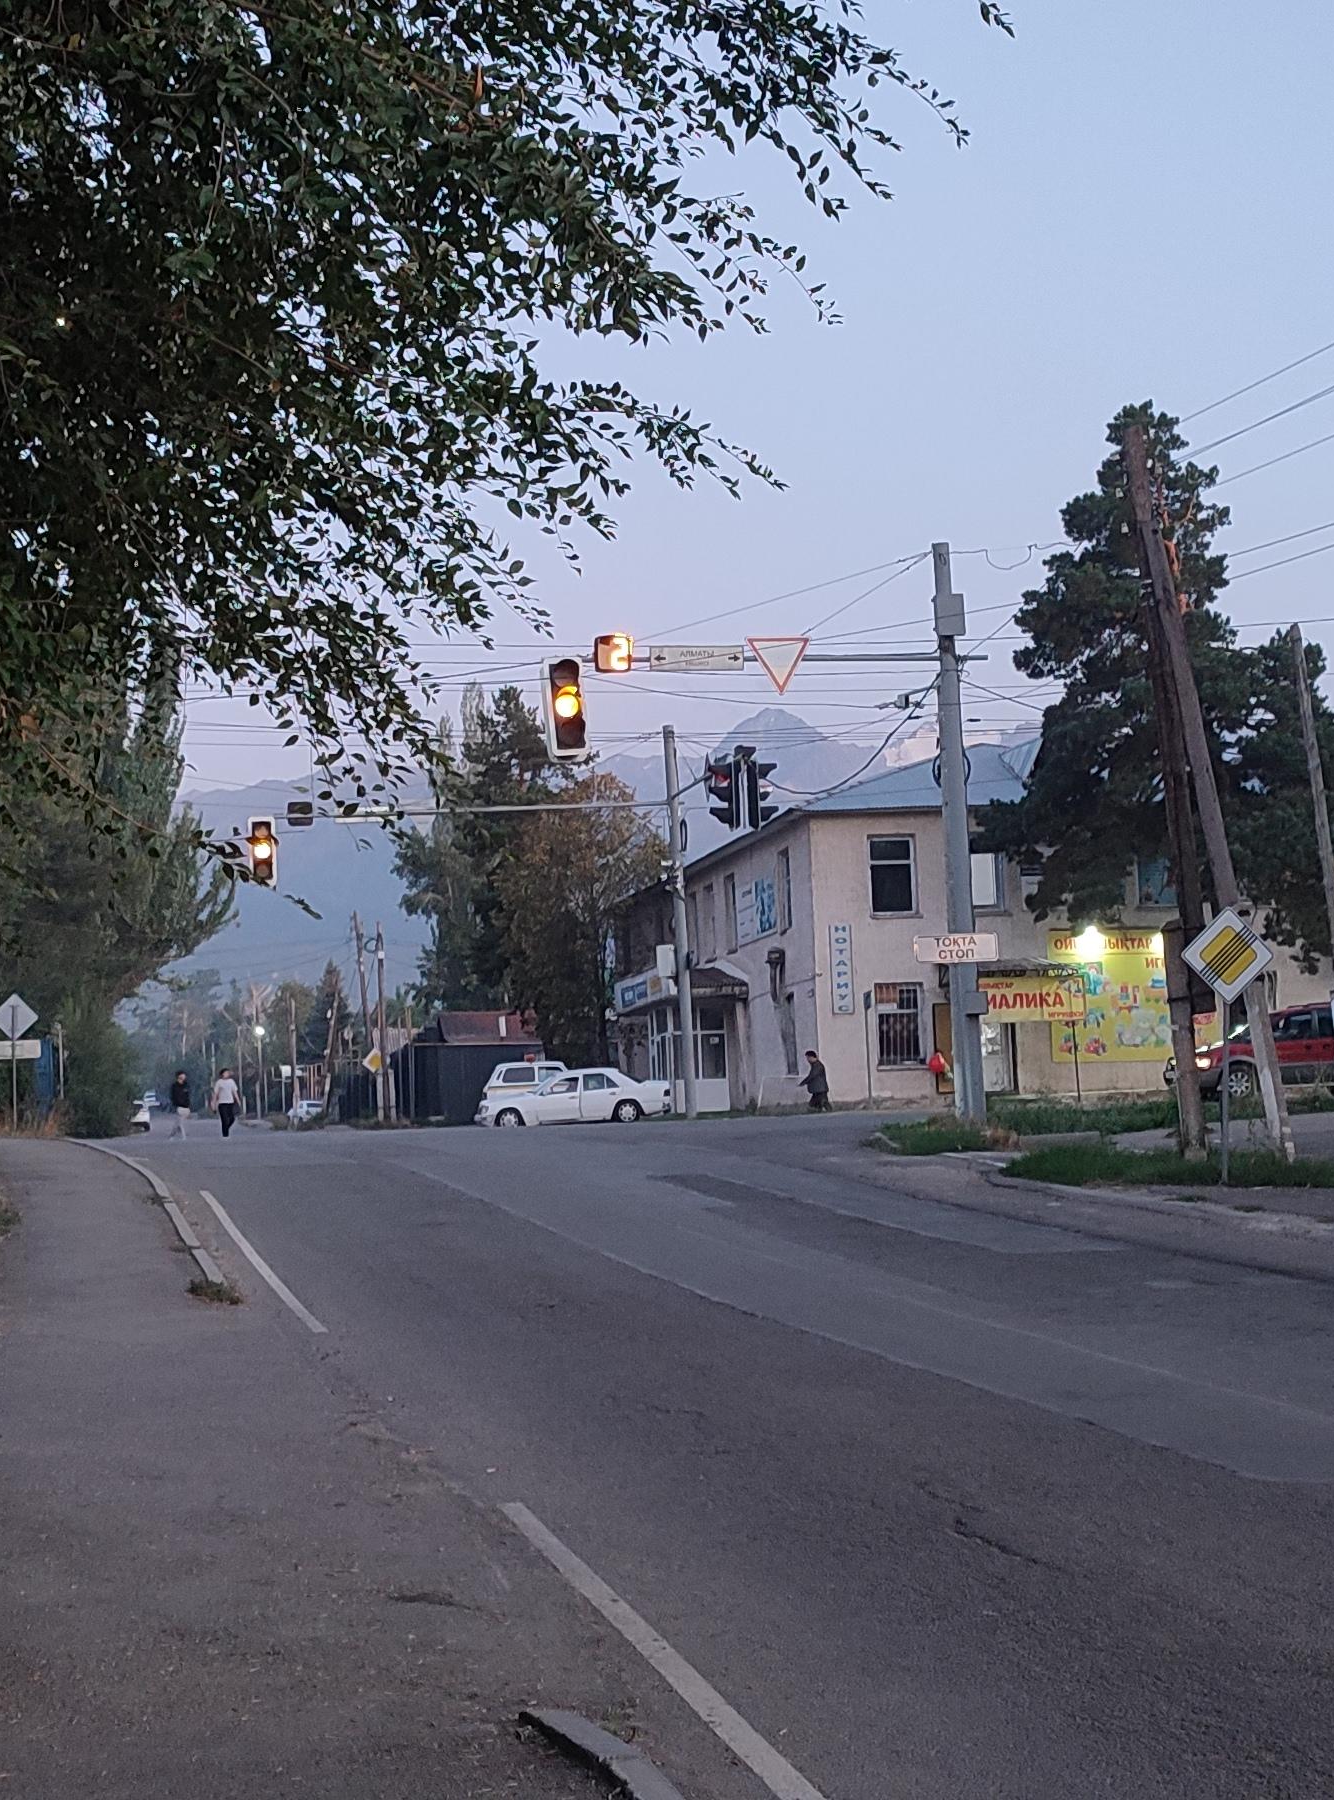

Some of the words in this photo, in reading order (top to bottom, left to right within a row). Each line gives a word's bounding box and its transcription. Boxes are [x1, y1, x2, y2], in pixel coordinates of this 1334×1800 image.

[679, 649, 715, 658] АЛМАТЫ
[934, 936, 977, 948] ТОҚТА
[938, 949, 975, 960] СТОП
[834, 925, 850, 1012] НОТАРИУС
